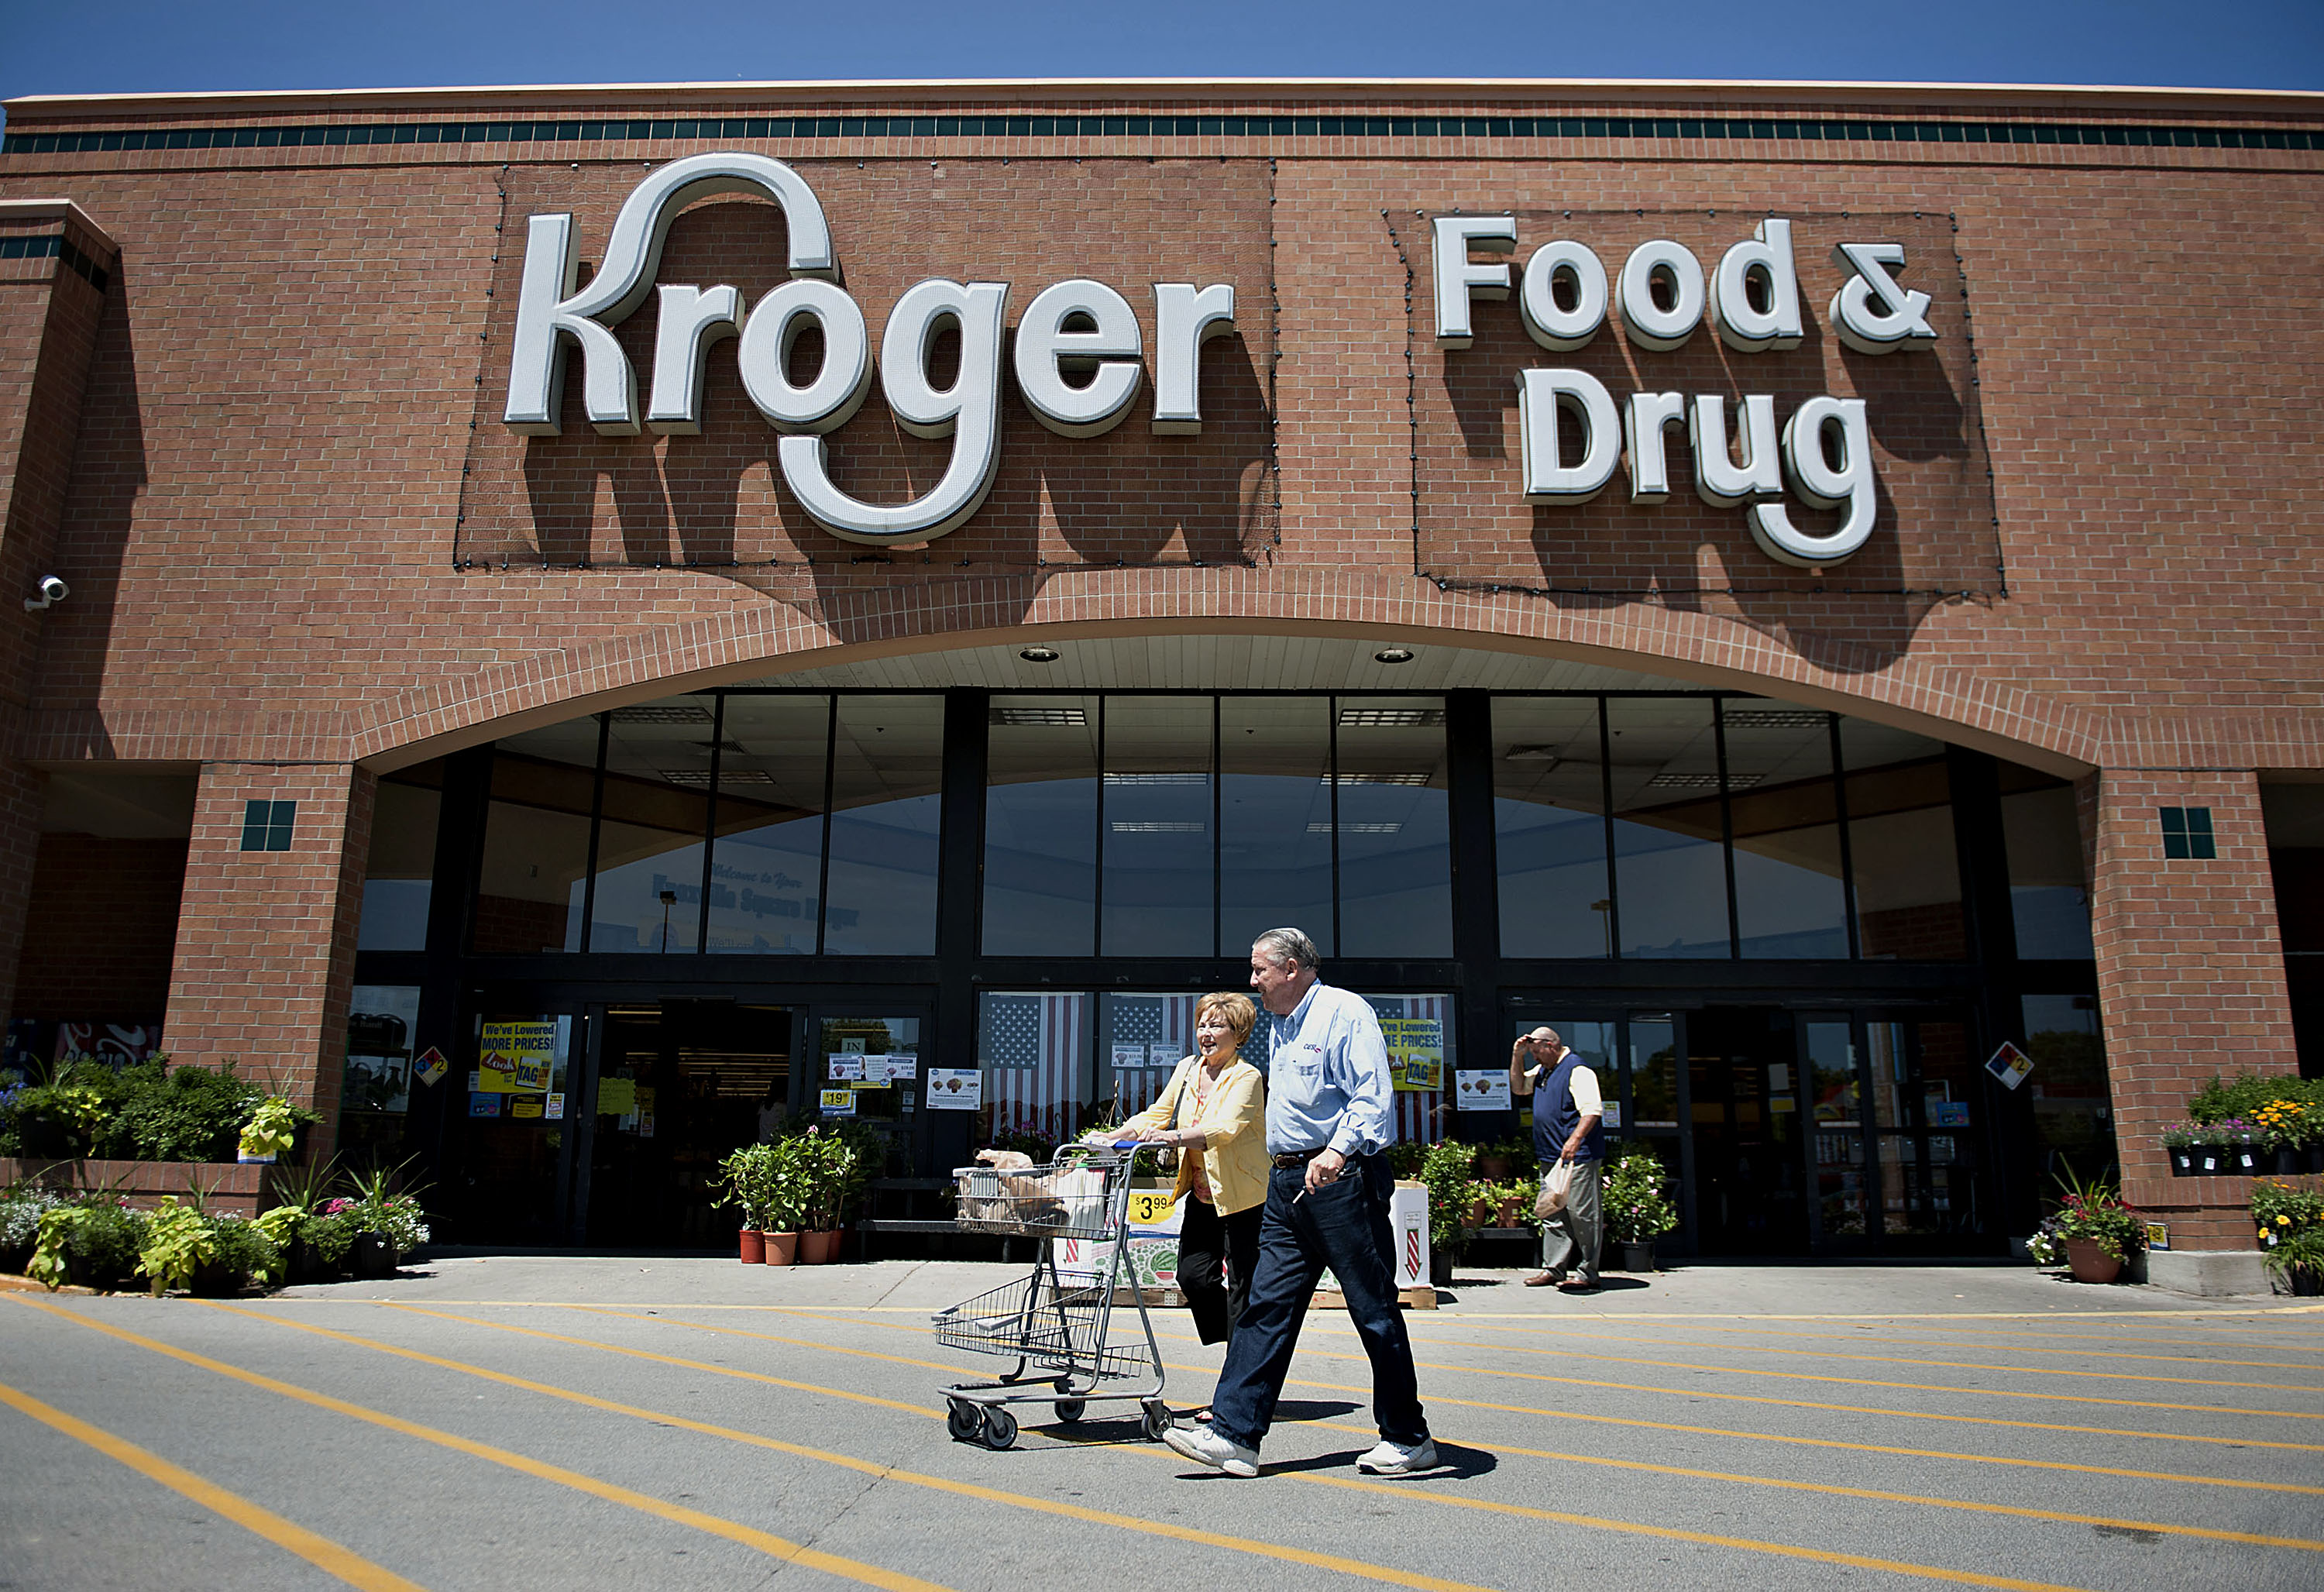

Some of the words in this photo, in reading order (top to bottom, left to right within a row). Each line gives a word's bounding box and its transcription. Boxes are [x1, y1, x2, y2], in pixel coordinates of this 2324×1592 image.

[1432, 216, 1804, 352] Food
[1829, 242, 1937, 355] &
[504, 150, 1236, 545] Kroger
[1514, 367, 1878, 569] Drug
[761, 871, 773, 883] to
[486, 1024, 512, 1035] We've
[515, 1023, 554, 1035] Lowered
[1379, 1021, 1397, 1032] e've
[1401, 1021, 1440, 1032] Lowered
[483, 1038, 511, 1050] MORE
[514, 1037, 554, 1050] PRICES!
[847, 1042, 861, 1051] IN
[1384, 1034, 1397, 1047] RE
[1401, 1034, 1442, 1047] PRICES!
[437, 1059, 444, 1071] 2
[486, 1052, 514, 1070] Look
[2016, 1057, 2024, 1071] 2
[518, 1065, 539, 1082] TAG
[1408, 1062, 1428, 1080] TAG
